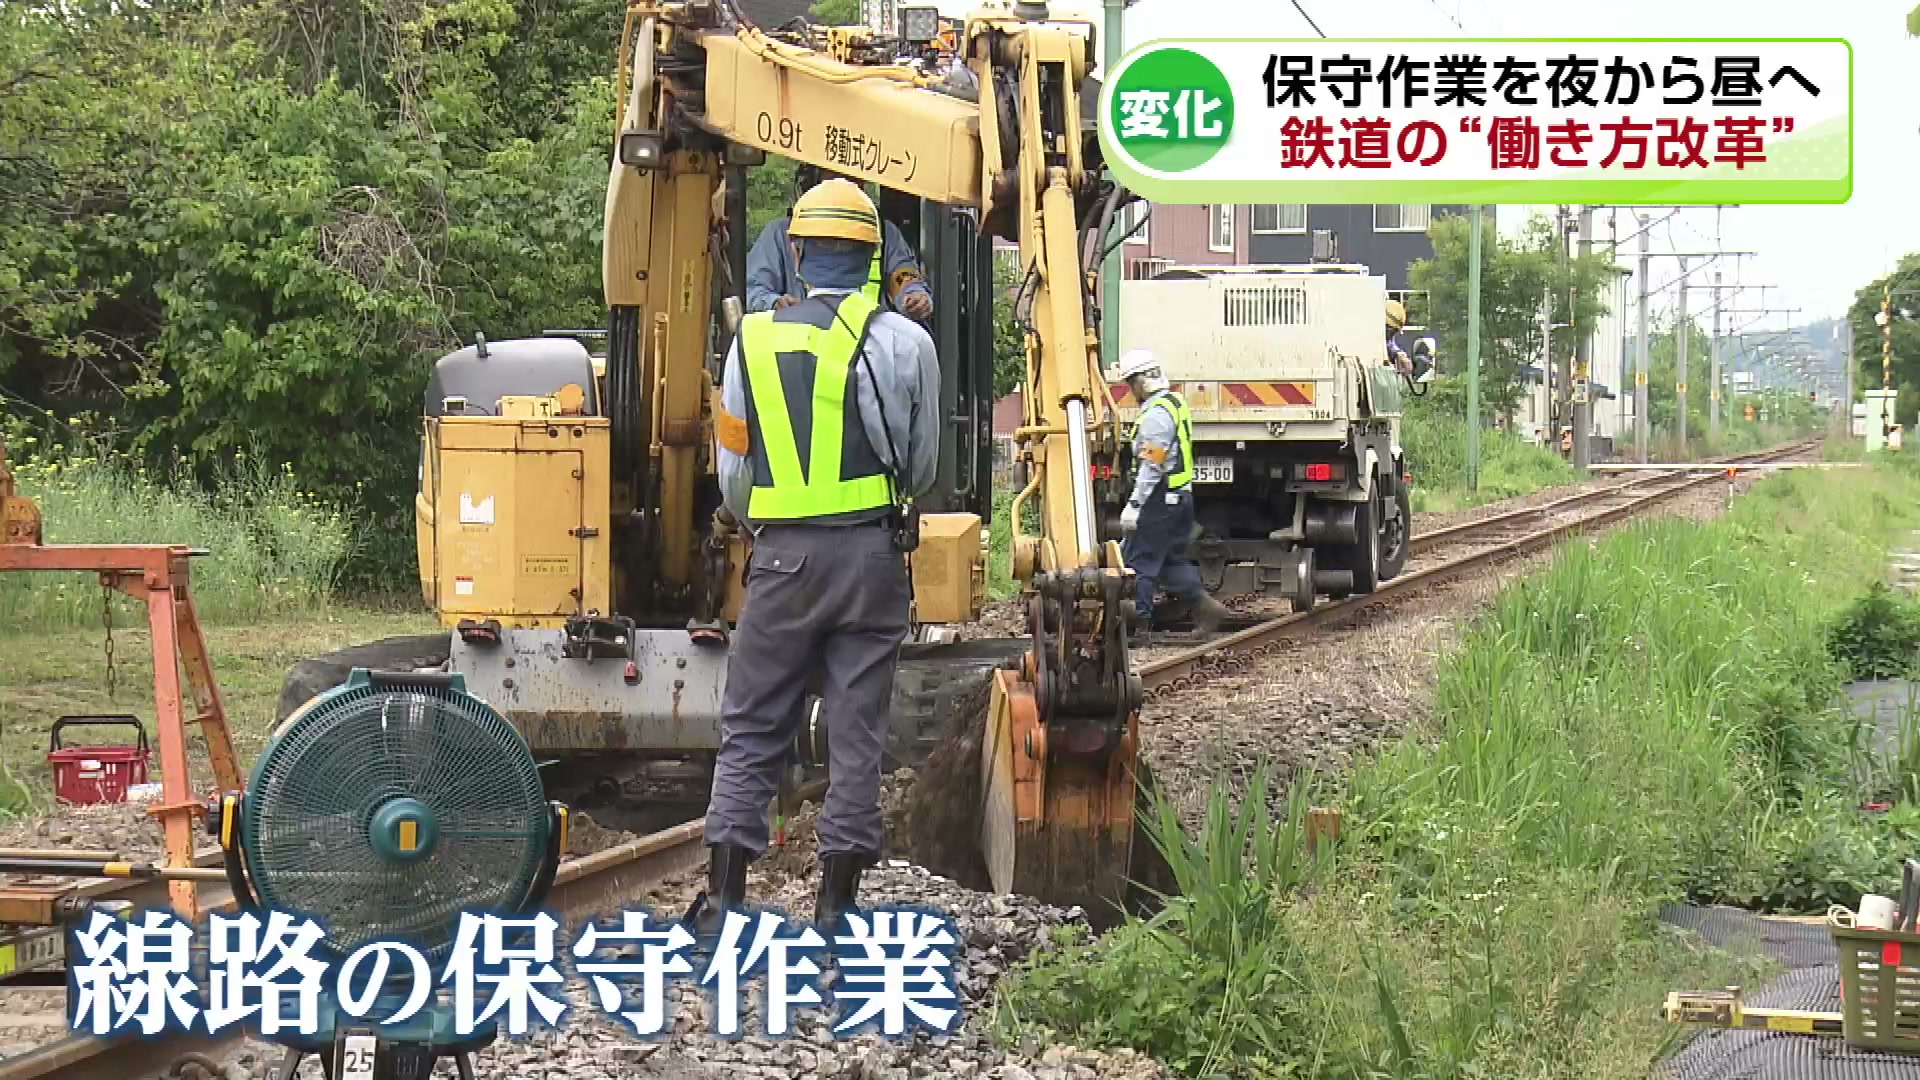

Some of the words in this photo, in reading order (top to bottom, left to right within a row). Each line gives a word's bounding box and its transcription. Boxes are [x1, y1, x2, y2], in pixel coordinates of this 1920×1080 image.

[757, 111, 802, 152] 0.9t
[825, 123, 917, 183] 移動式クレーン
[345, 1048, 374, 1073] 25
